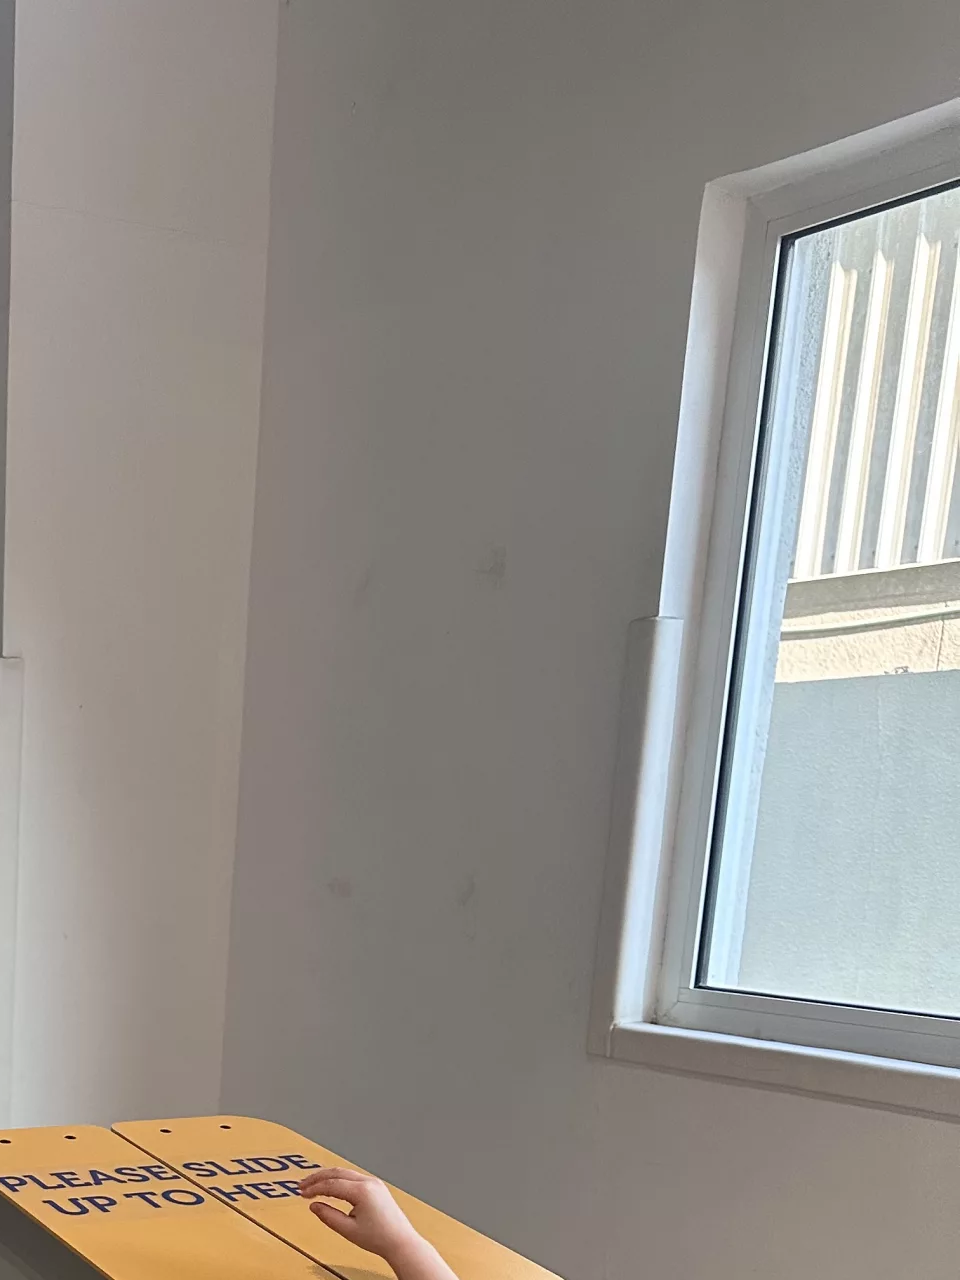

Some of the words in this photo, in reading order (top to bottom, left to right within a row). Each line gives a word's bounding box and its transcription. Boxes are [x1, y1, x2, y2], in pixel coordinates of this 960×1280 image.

[182, 1154, 321, 1177] SLIDE
[42, 1196, 117, 1216] UP
[124, 1189, 205, 1208] TO
[208, 1180, 303, 1202] HER
